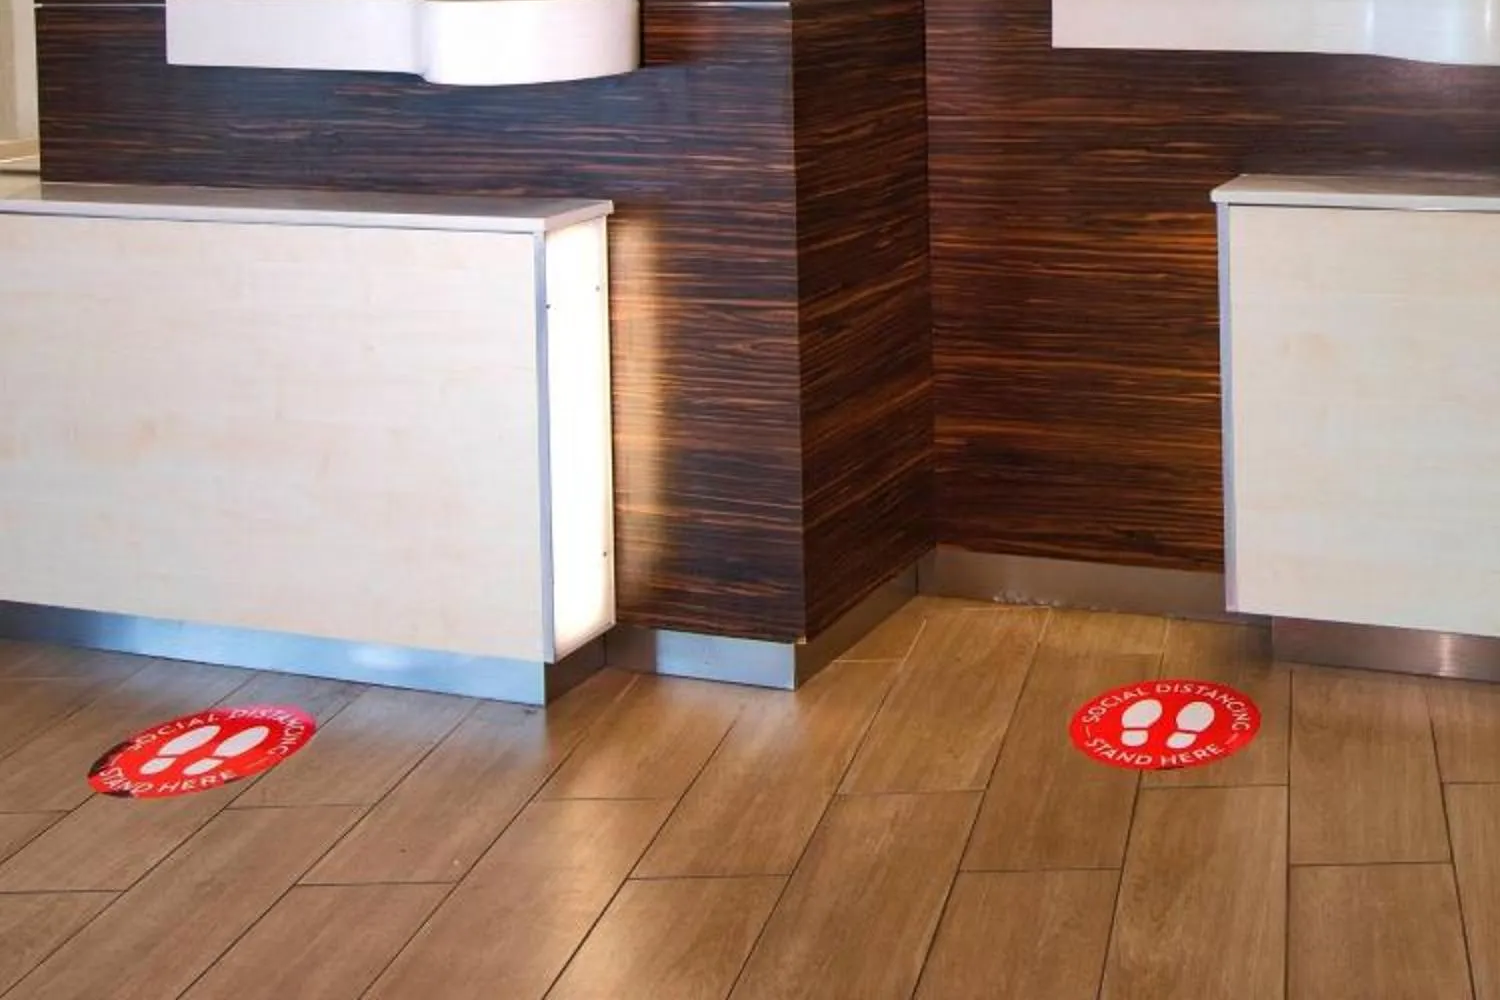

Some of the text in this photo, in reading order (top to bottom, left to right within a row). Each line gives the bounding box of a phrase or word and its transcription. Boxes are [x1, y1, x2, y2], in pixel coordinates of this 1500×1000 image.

[1081, 683, 1251, 731] SOCIAL DISTANCING
[127, 713, 220, 752] SOCIAL
[1084, 737, 1225, 766] STAND HERE
[99, 769, 238, 794] STAND HERE
